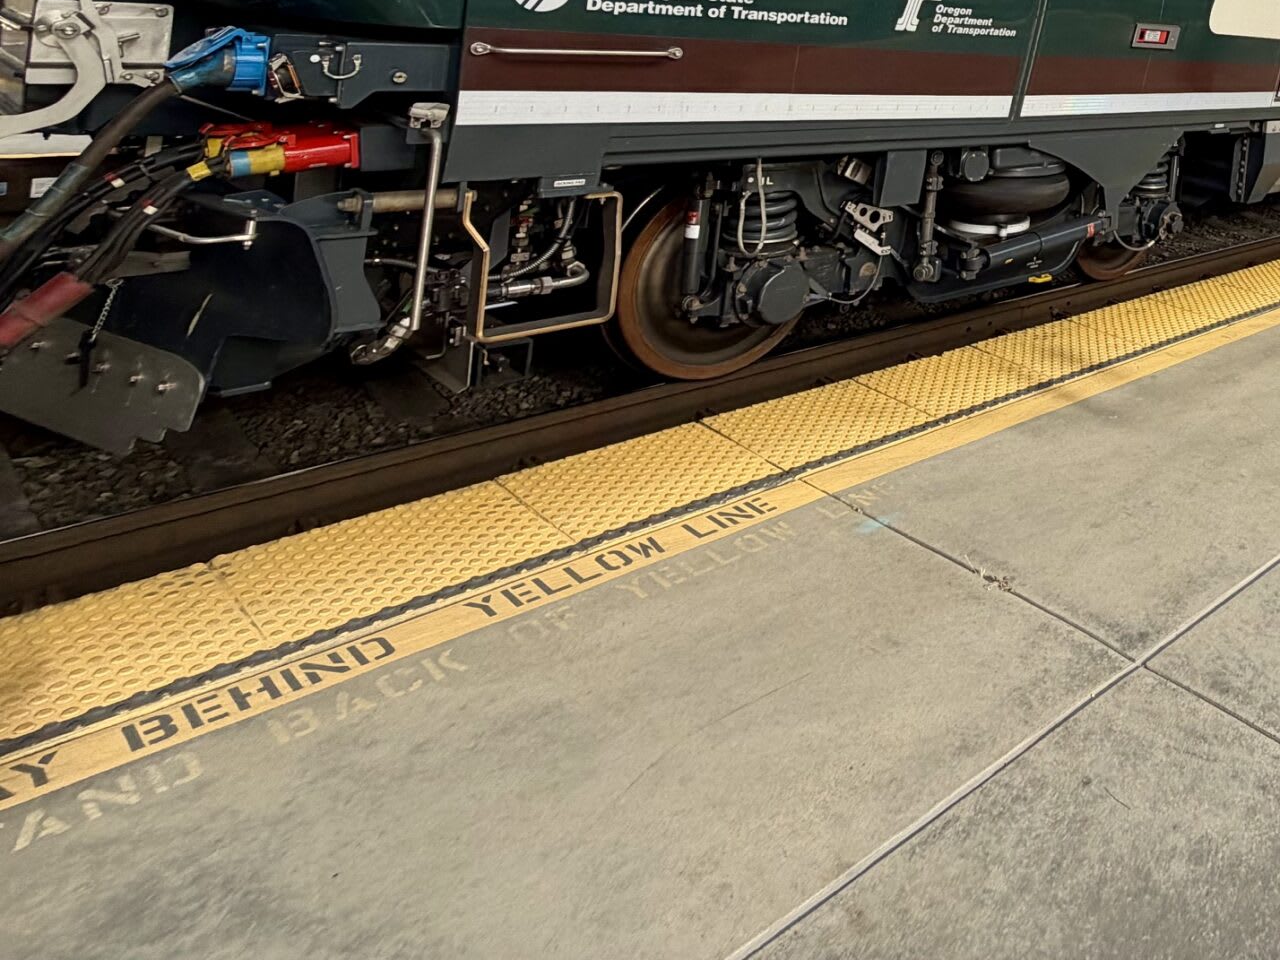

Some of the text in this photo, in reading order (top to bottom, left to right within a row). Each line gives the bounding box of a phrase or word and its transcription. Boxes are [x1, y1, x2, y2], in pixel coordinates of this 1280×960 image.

[707, 5, 727, 19] of
[731, 6, 848, 26] Transportation
[935, 4, 973, 17] Oregon
[933, 14, 993, 27] Department
[931, 24, 1017, 37] of Transportation
[121, 637, 396, 752] BEHIND
[463, 536, 666, 618] YELLOW
[681, 497, 778, 539] LINE
[11, 751, 203, 853] AND
[267, 648, 469, 744] BACK
[615, 520, 797, 600] YELLOW
